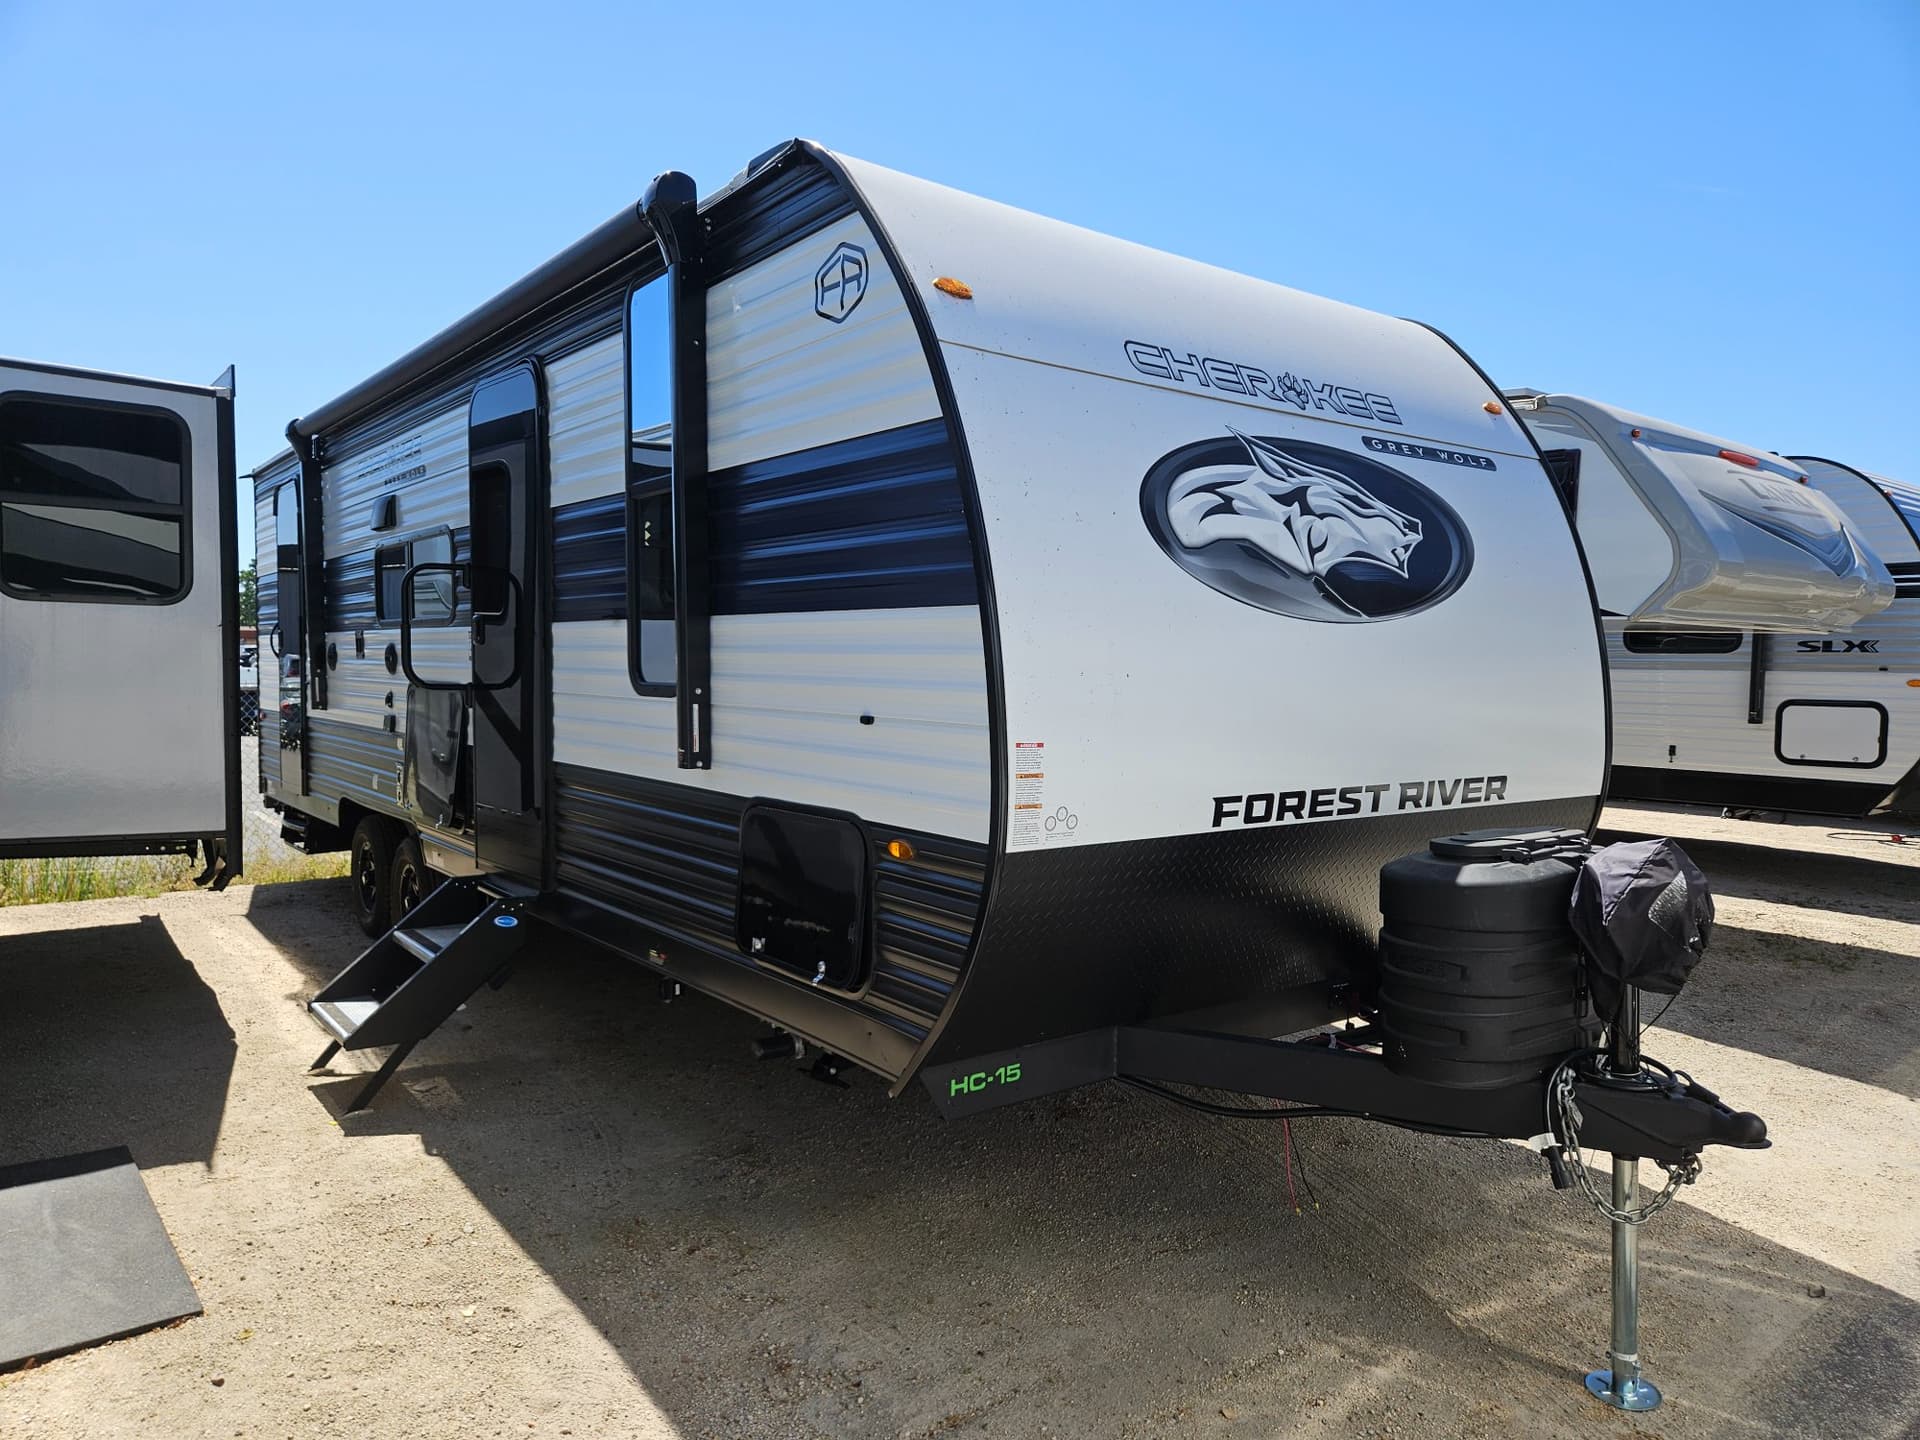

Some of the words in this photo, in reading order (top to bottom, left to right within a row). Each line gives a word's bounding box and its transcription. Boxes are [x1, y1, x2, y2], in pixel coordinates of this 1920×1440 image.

[1372, 439, 1424, 457] GREY
[1437, 449, 1488, 468] WOLF
[1212, 784, 1391, 828] FOREST
[1398, 775, 1508, 810] RIVER
[950, 1063, 1021, 1097] HC-15
